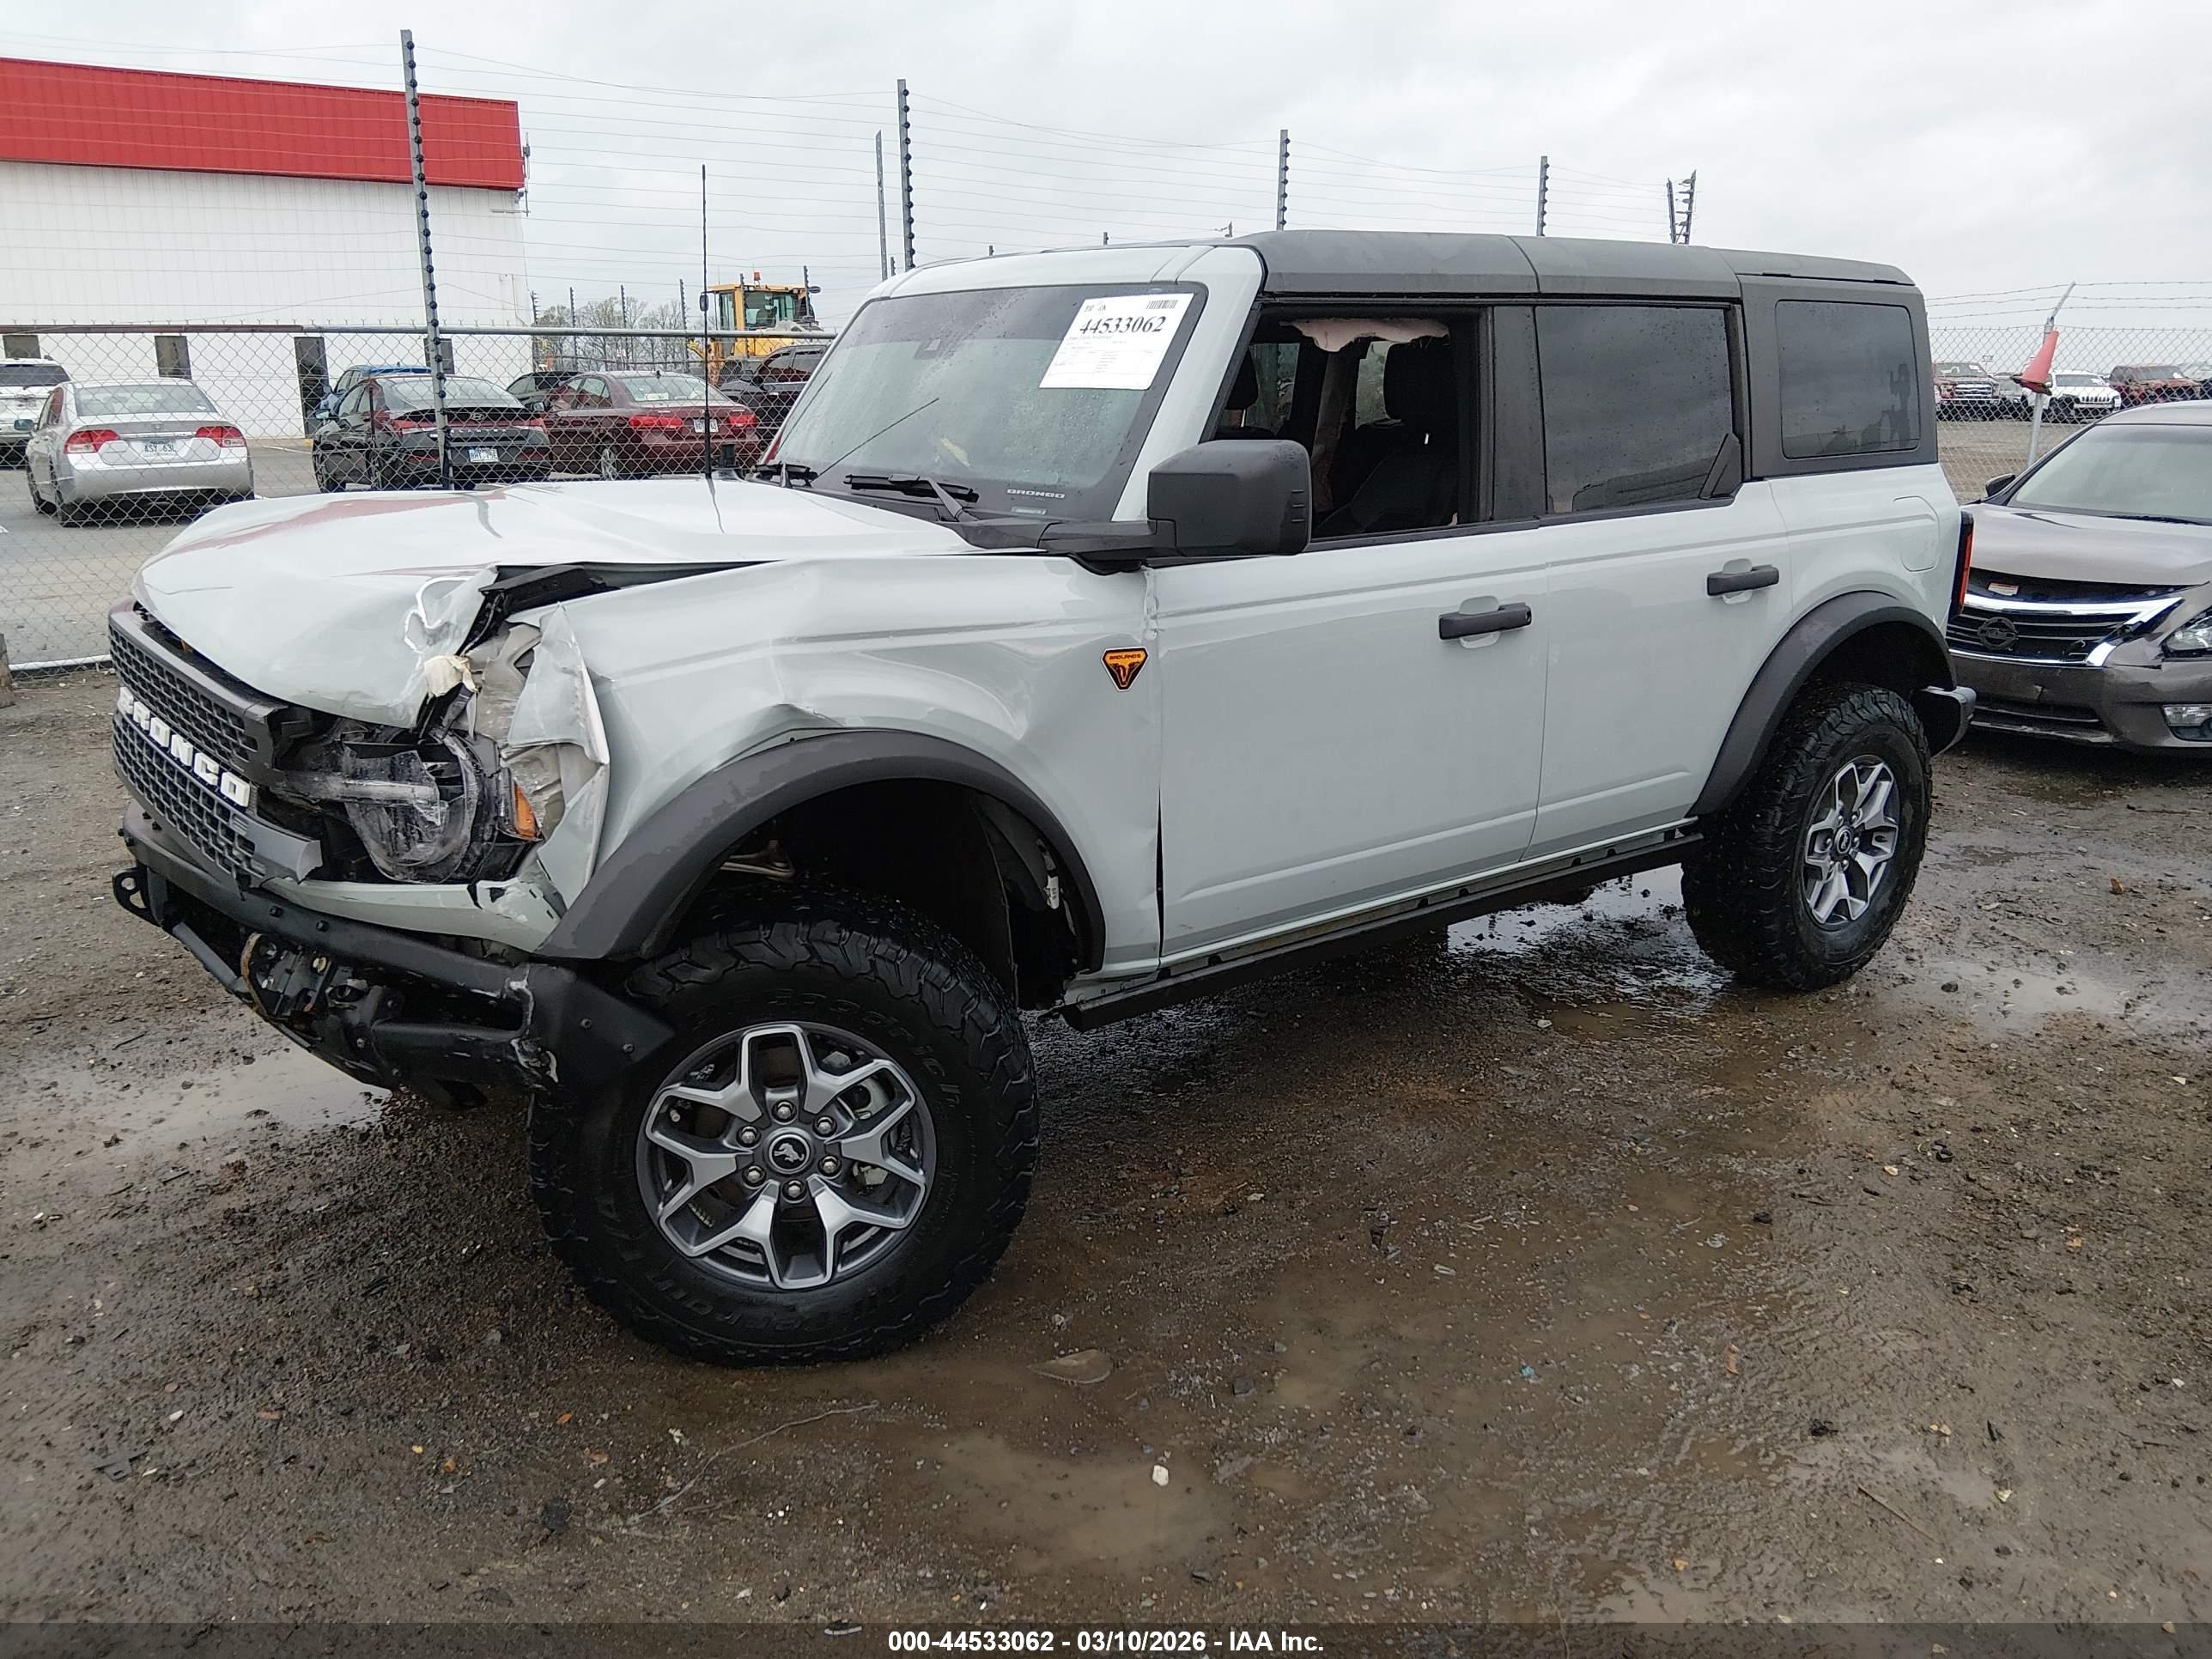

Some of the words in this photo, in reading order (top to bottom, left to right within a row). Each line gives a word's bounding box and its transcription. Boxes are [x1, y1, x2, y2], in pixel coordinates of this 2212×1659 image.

[1079, 315, 1166, 335] 44533062
[1006, 489, 1065, 499] BRONCO
[118, 687, 251, 808] BRONCO
